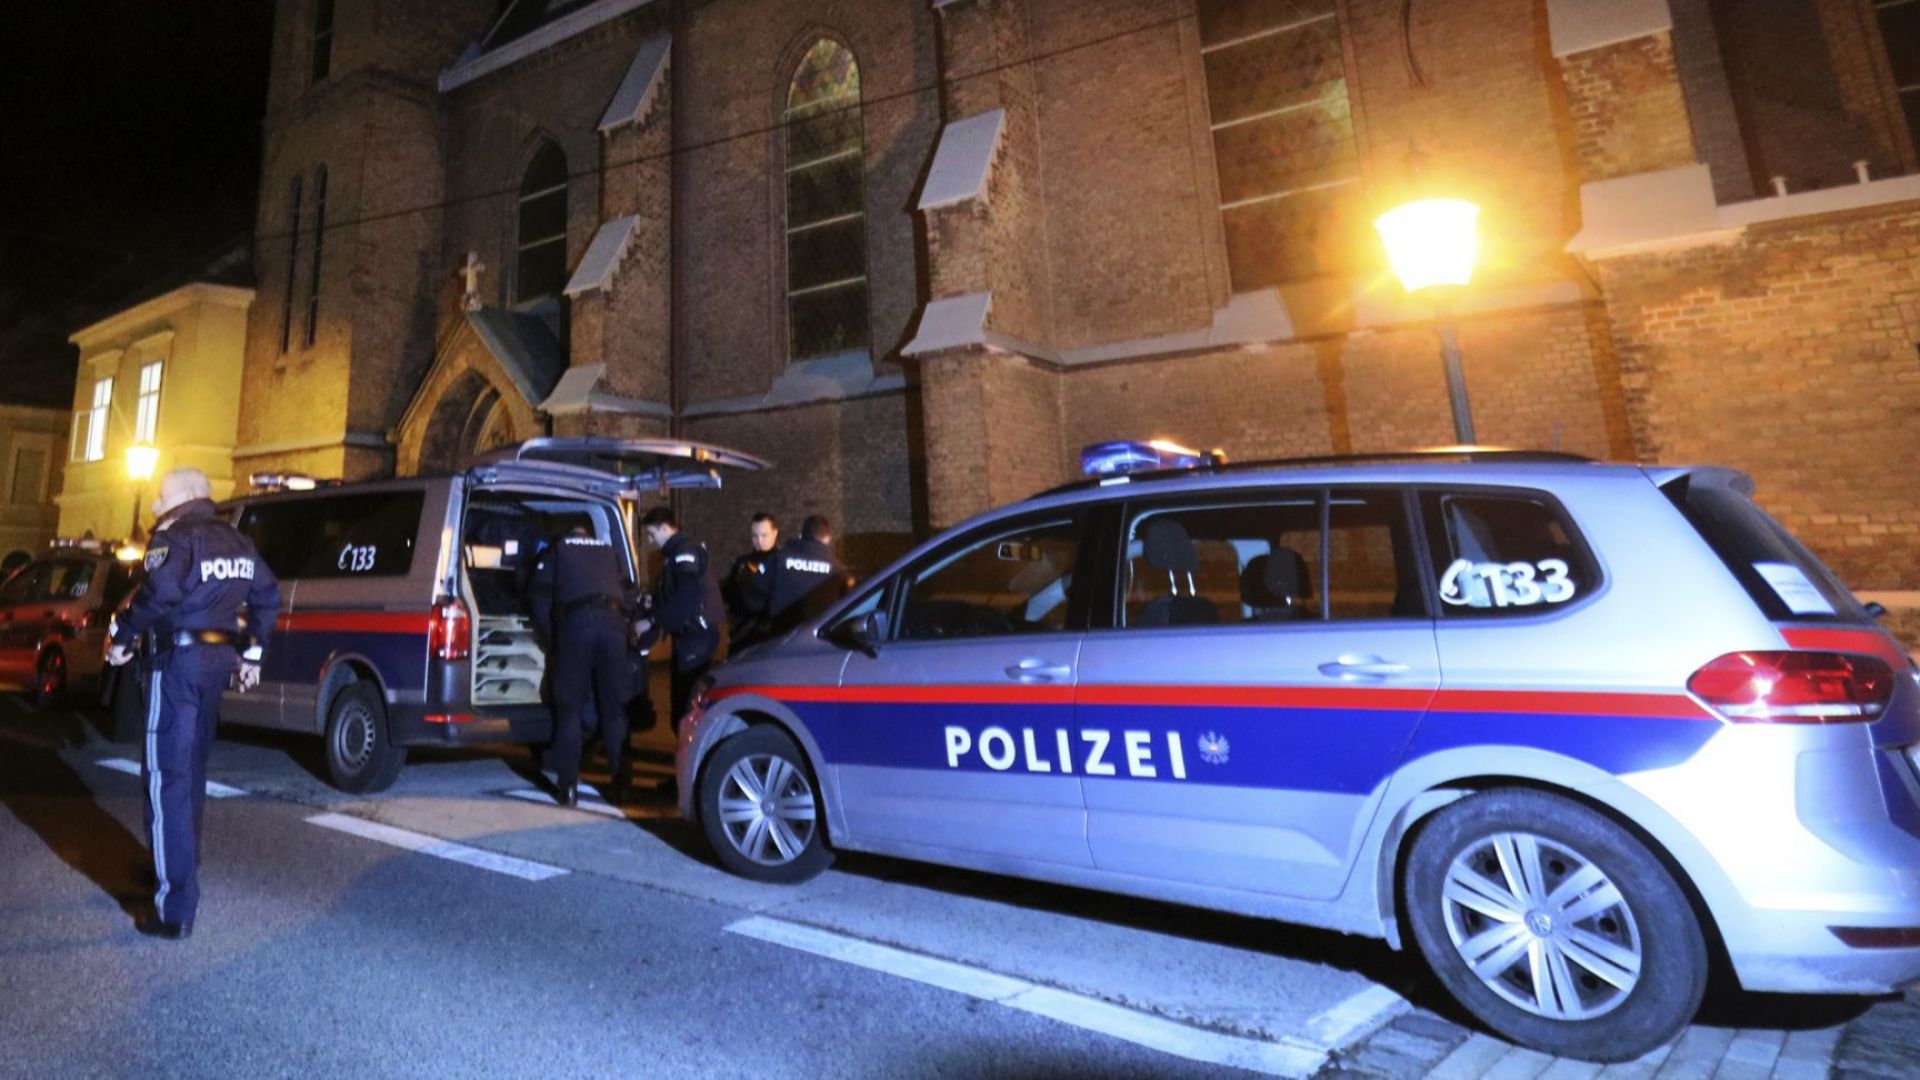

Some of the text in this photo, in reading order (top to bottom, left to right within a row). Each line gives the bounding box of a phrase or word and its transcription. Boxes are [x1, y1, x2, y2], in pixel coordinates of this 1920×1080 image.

[351, 545, 376, 571] 133
[786, 558, 831, 574] POLIZEI
[1479, 558, 1576, 607] 133
[944, 725, 1187, 780] POLIZEI
